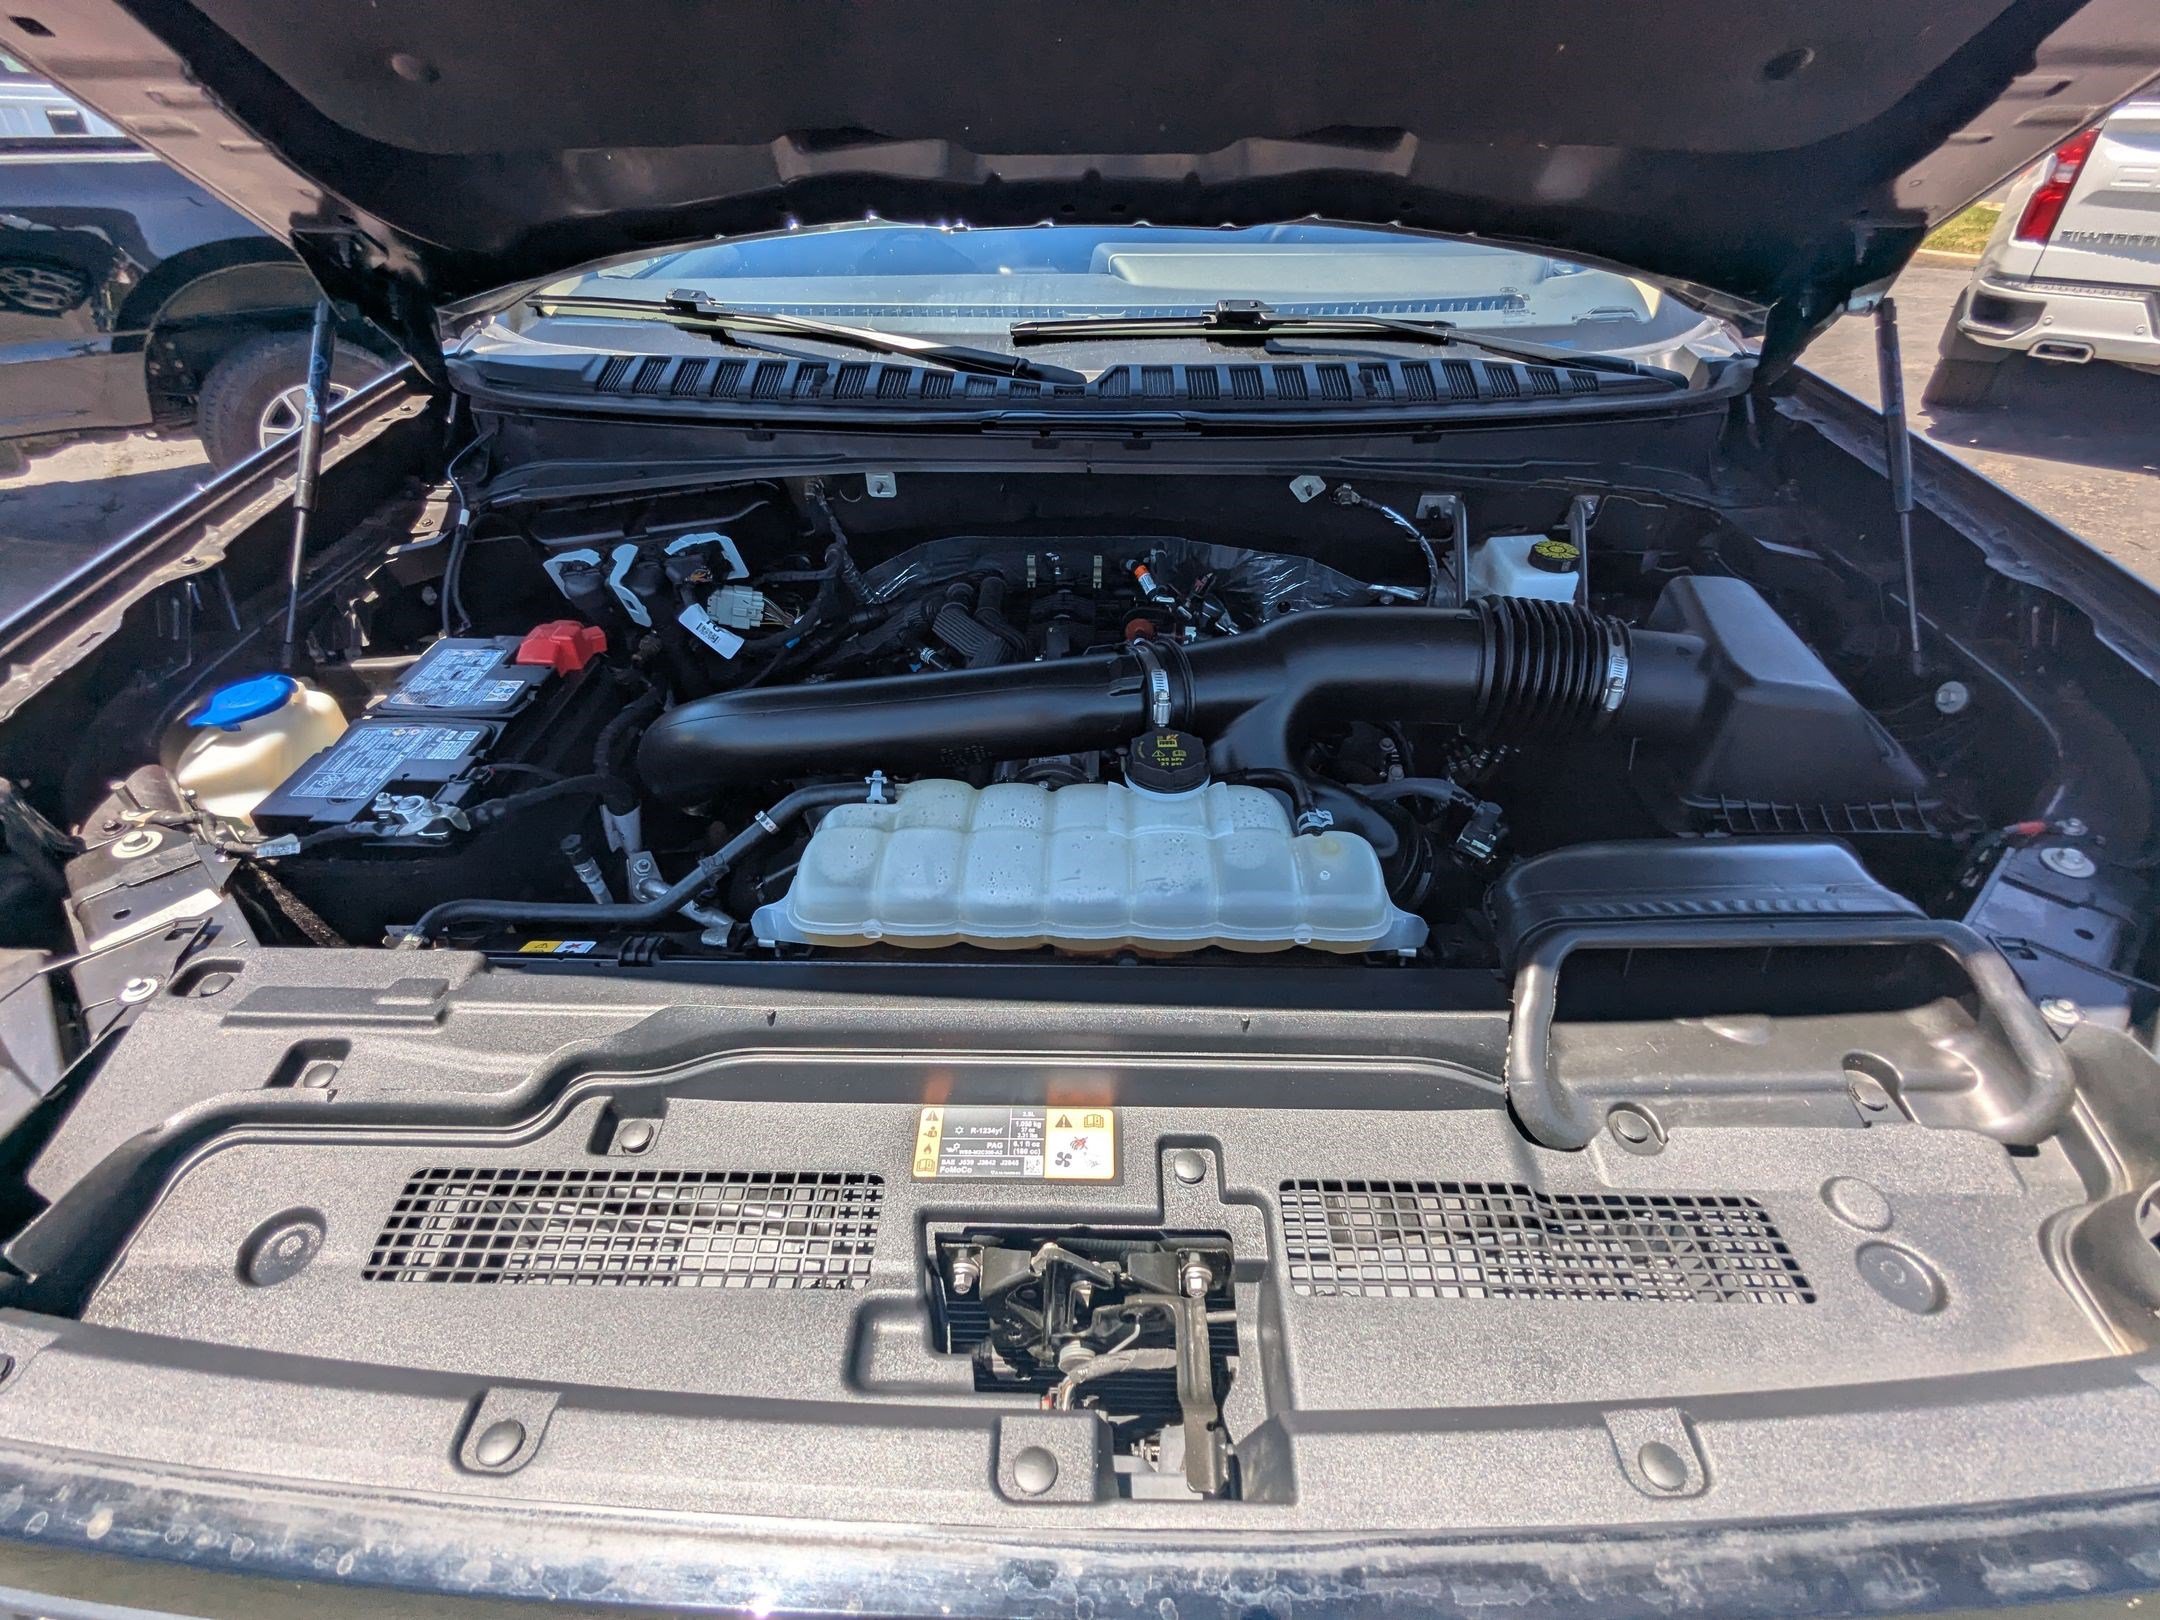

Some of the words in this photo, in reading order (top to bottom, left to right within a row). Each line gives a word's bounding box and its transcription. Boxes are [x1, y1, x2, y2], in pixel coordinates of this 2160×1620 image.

[2061, 229, 2160, 247] SILVERAD
[970, 1127, 1003, 1135] R-1234yf
[939, 1166, 973, 1174] FoMoCo
